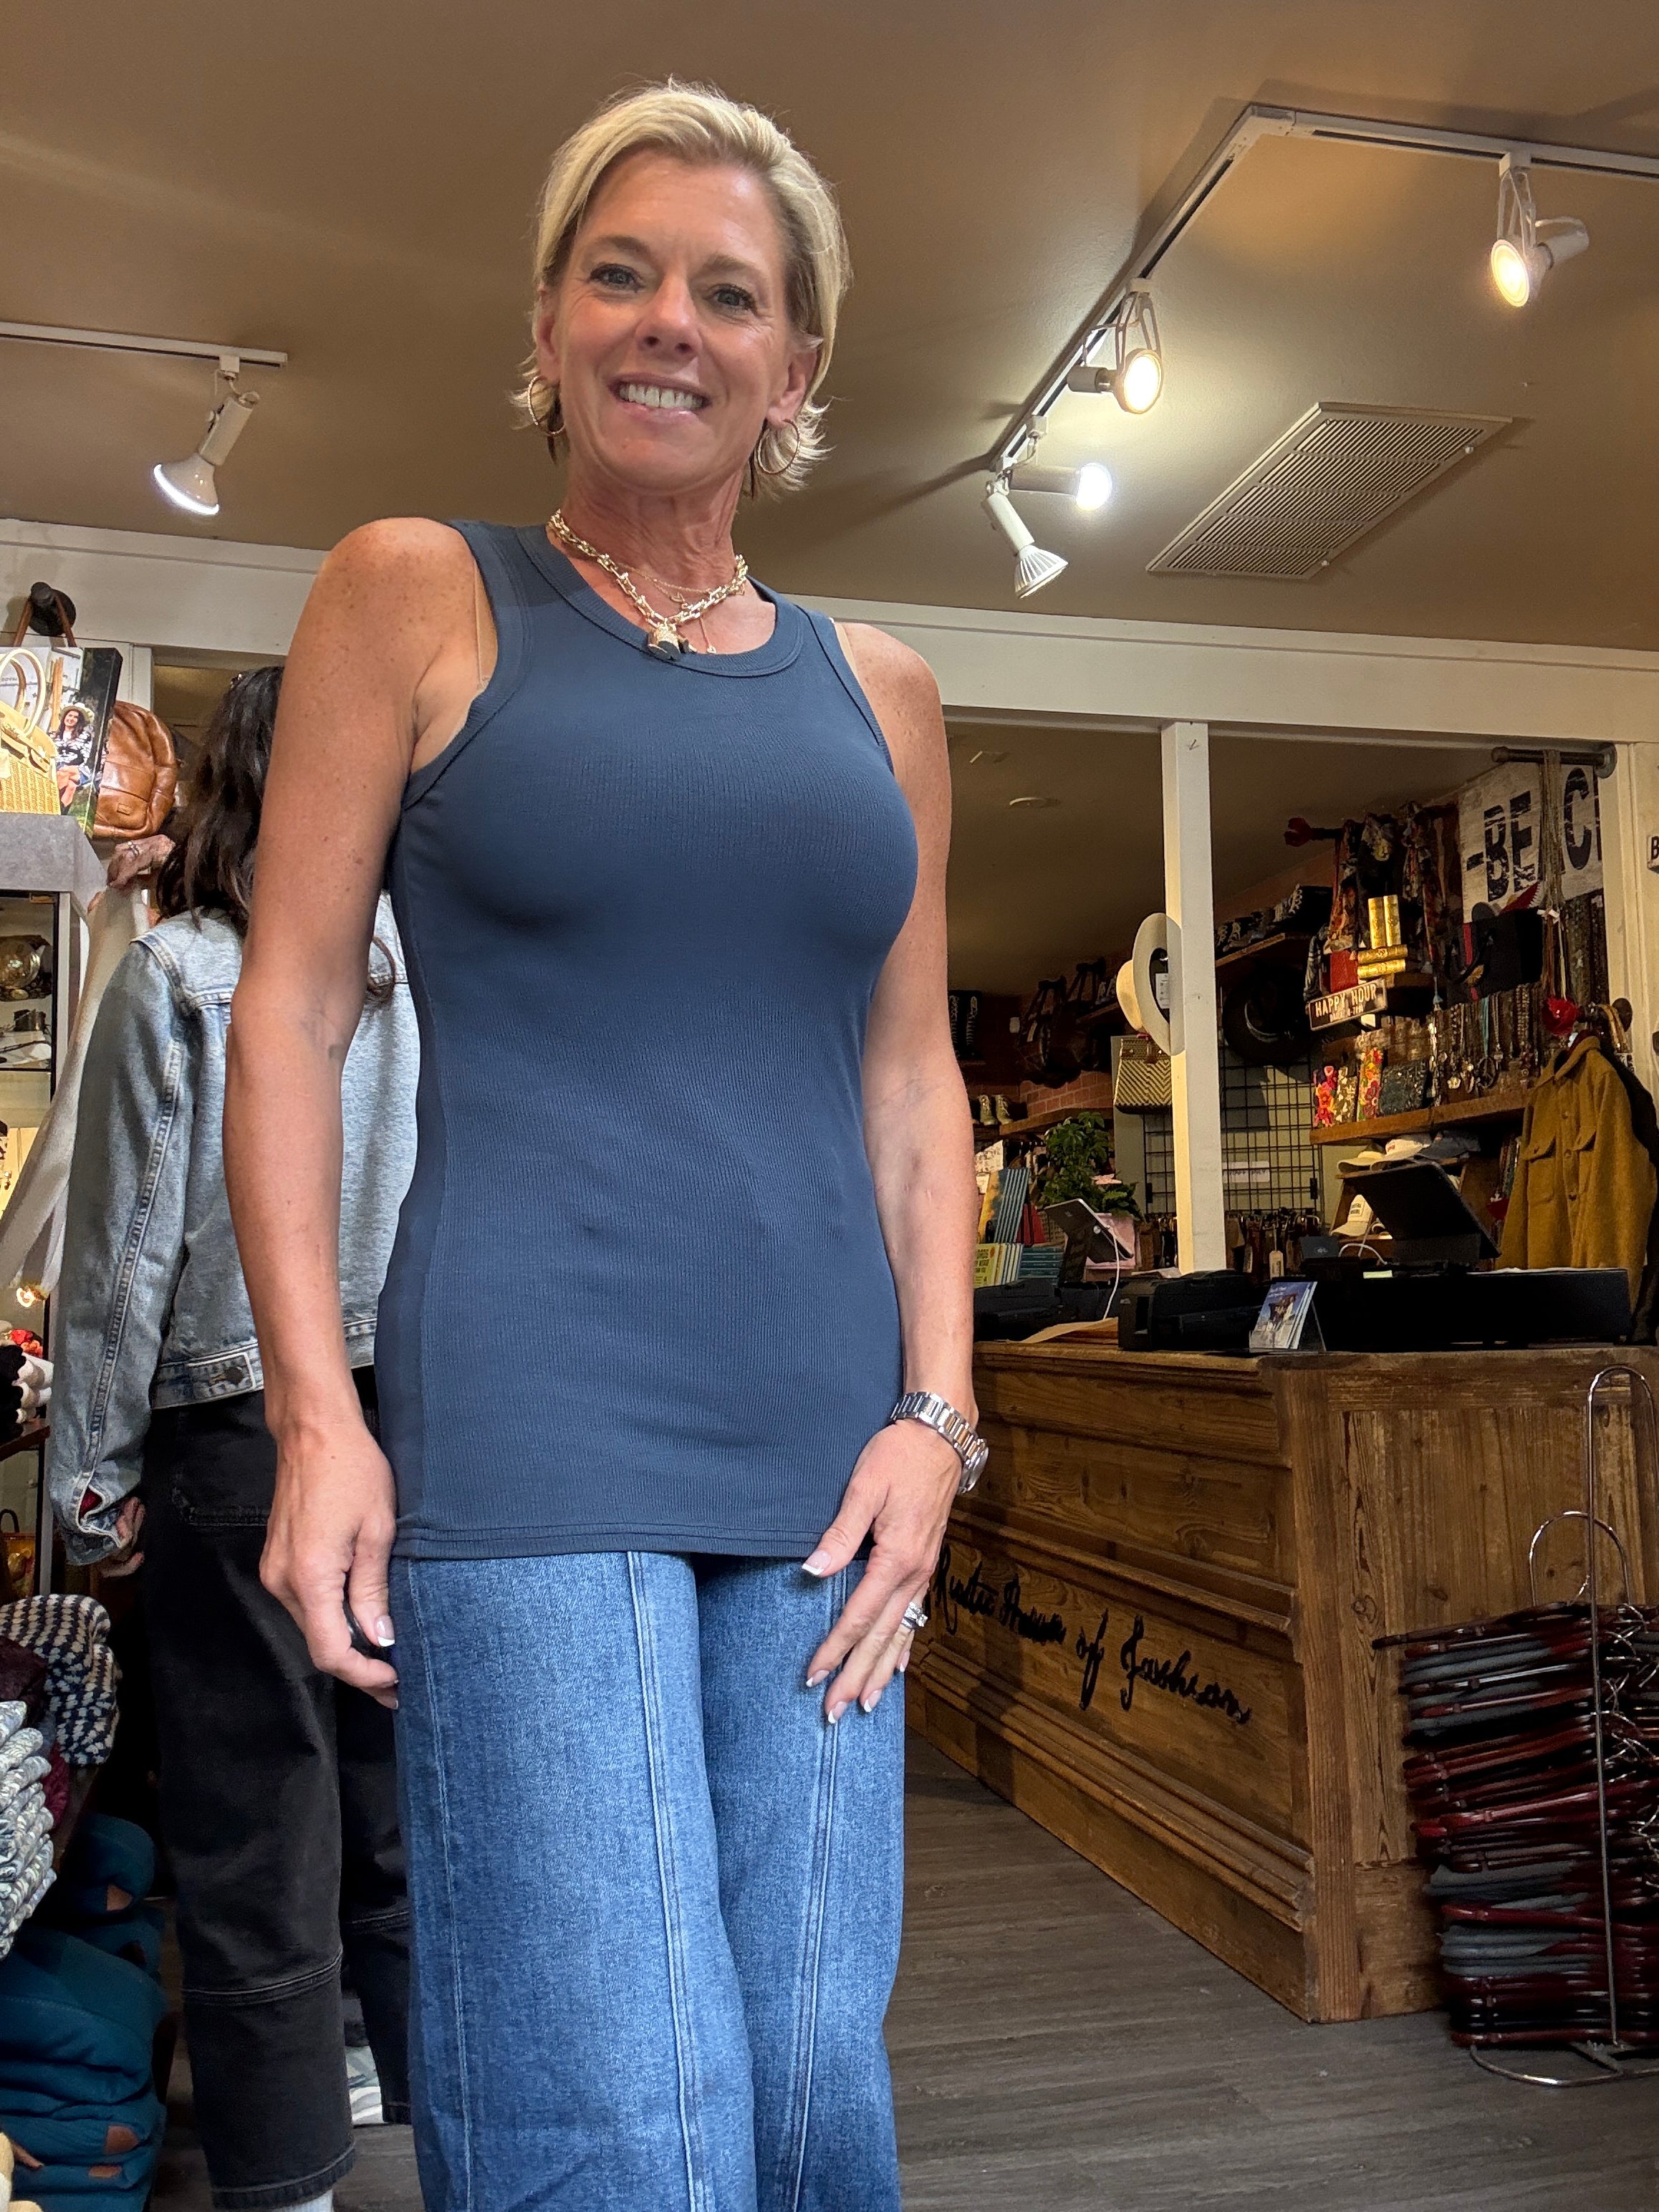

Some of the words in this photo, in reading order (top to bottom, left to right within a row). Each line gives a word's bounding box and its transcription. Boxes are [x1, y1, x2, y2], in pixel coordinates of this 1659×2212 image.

[1315, 993, 1346, 1017] HAPPY
[1351, 984, 1377, 1006] HOUR
[1076, 1607, 1109, 1711] of
